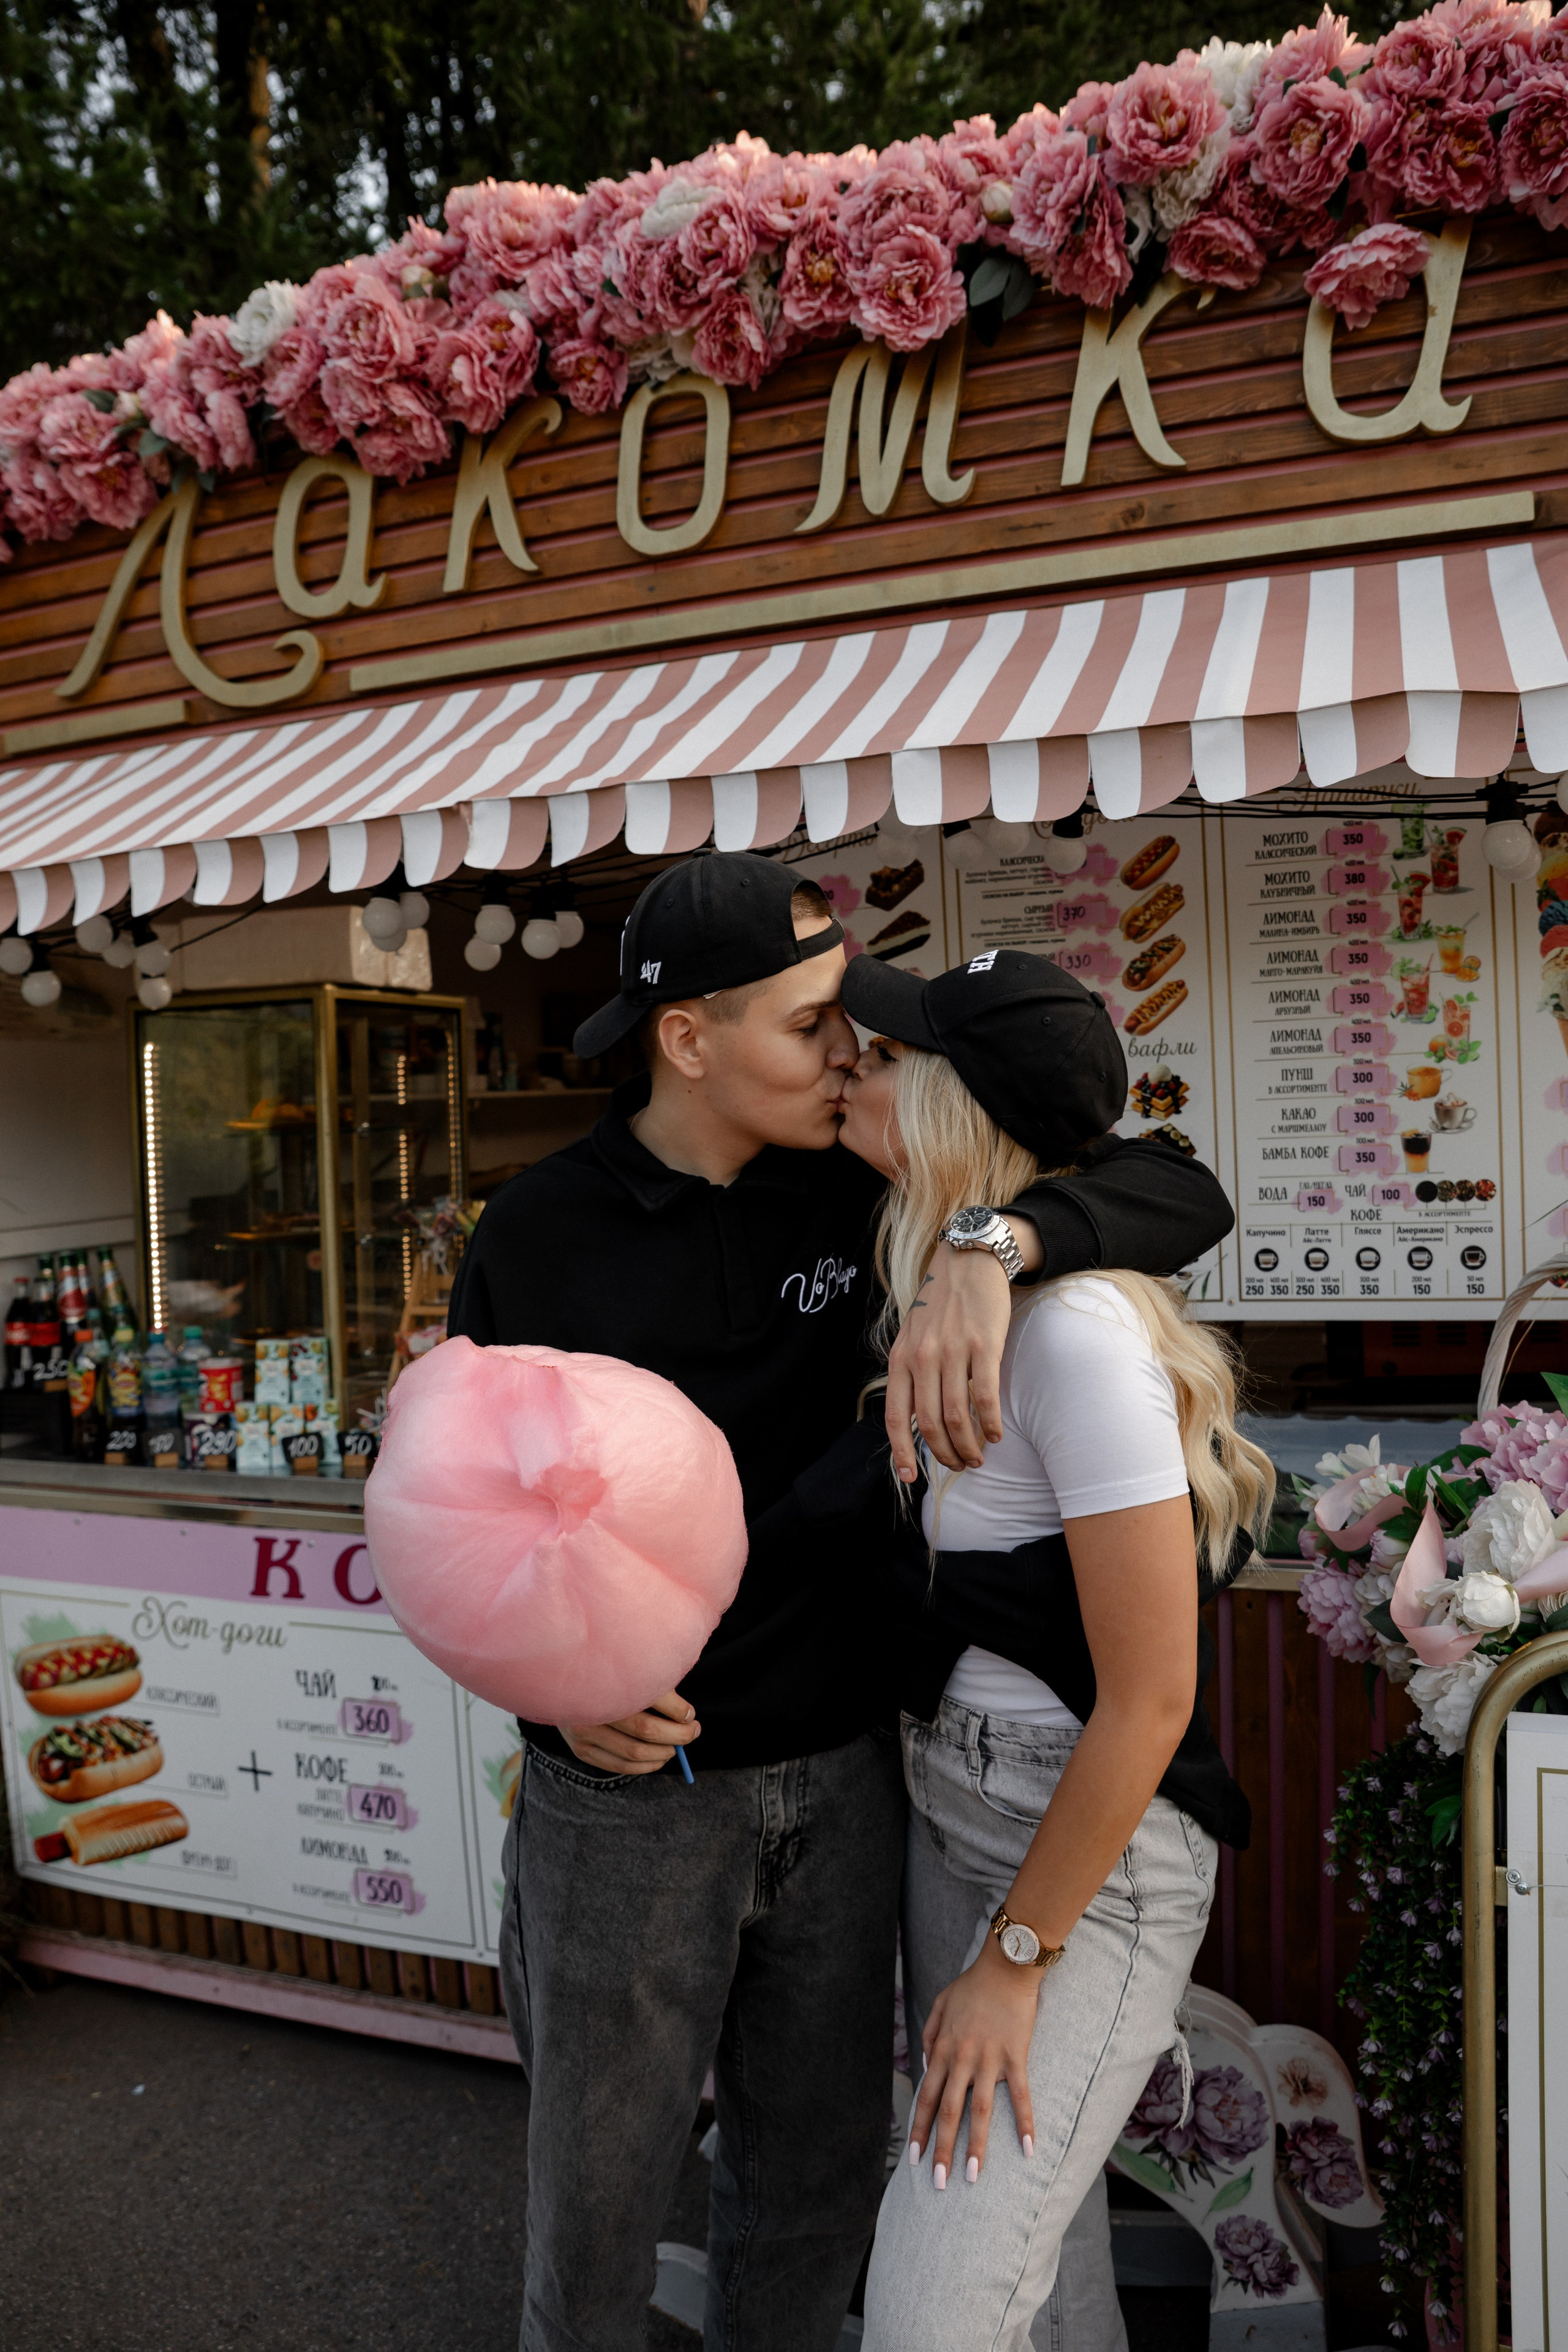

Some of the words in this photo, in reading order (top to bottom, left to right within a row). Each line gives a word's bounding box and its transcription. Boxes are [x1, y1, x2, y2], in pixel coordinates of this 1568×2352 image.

[1262, 831, 1309, 846] МОХИТО
[1343, 834, 1363, 845] 350
[1255, 845, 1317, 860] КЛАССИЧЕСКИЙ
[1264, 870, 1310, 886] МОХИТО
[1344, 873, 1365, 884] 380
[1260, 884, 1315, 899] КЛУБНИЧНЫЙ
[1263, 910, 1315, 925] ЛИМОНАД
[1346, 913, 1367, 924] 350
[1267, 949, 1319, 965] ЛИМОНАД
[1348, 952, 1368, 964] 350
[640, 959, 662, 984] 47
[1268, 989, 1321, 1004] ЛИМОНАД
[1349, 993, 1370, 1005] 350
[1275, 1005, 1311, 1016] АРБУЗНЫЙ
[1270, 1028, 1322, 1042] ЛИМОНАД
[1351, 1032, 1371, 1044] 350
[1128, 1037, 1197, 1063] вафли
[1270, 1044, 1323, 1055] АПЕЛЬСИНОВЫЙ
[1281, 1068, 1314, 1081] ПУНШ
[1352, 1072, 1373, 1084] 300
[1274, 1084, 1327, 1094] АССОРТИМЕНТЕ
[1281, 1107, 1316, 1120] КАКАО
[1354, 1112, 1374, 1123] 300
[1278, 1123, 1327, 1133] МАРШМЕЛЛОУ
[1262, 1147, 1297, 1160] БАМБЛ
[1300, 1146, 1329, 1159] КОФЕ
[1355, 1152, 1376, 1163] 350
[1258, 1187, 1287, 1201] ВОДА
[1344, 1183, 1366, 1197] ЧАЙ
[1381, 1189, 1400, 1200] 100
[1306, 1196, 1325, 1207] 150
[1350, 1208, 1382, 1221] КОФЕ
[1246, 1229, 1286, 1238] Капучино
[1354, 1227, 1381, 1235] Гляссе
[1396, 1226, 1444, 1236] Американо
[1454, 1225, 1493, 1235] Эспрессо
[1245, 1285, 1264, 1295] 250
[1270, 1284, 1289, 1295] 350
[1295, 1284, 1314, 1295] 250
[1321, 1284, 1340, 1295] 350
[1360, 1284, 1379, 1295] 350
[1413, 1284, 1431, 1295] 150
[1466, 1284, 1484, 1294] 150
[288, 1436, 318, 1457] 100
[345, 1435, 372, 1456] 50
[132, 1596, 288, 1655] Хот-доги
[295, 1668, 336, 1699] ЧАЙ
[353, 1704, 390, 1734] 360
[294, 1751, 349, 1784] КОФЕ
[359, 1791, 397, 1820] 470
[366, 1875, 404, 1904] 550
